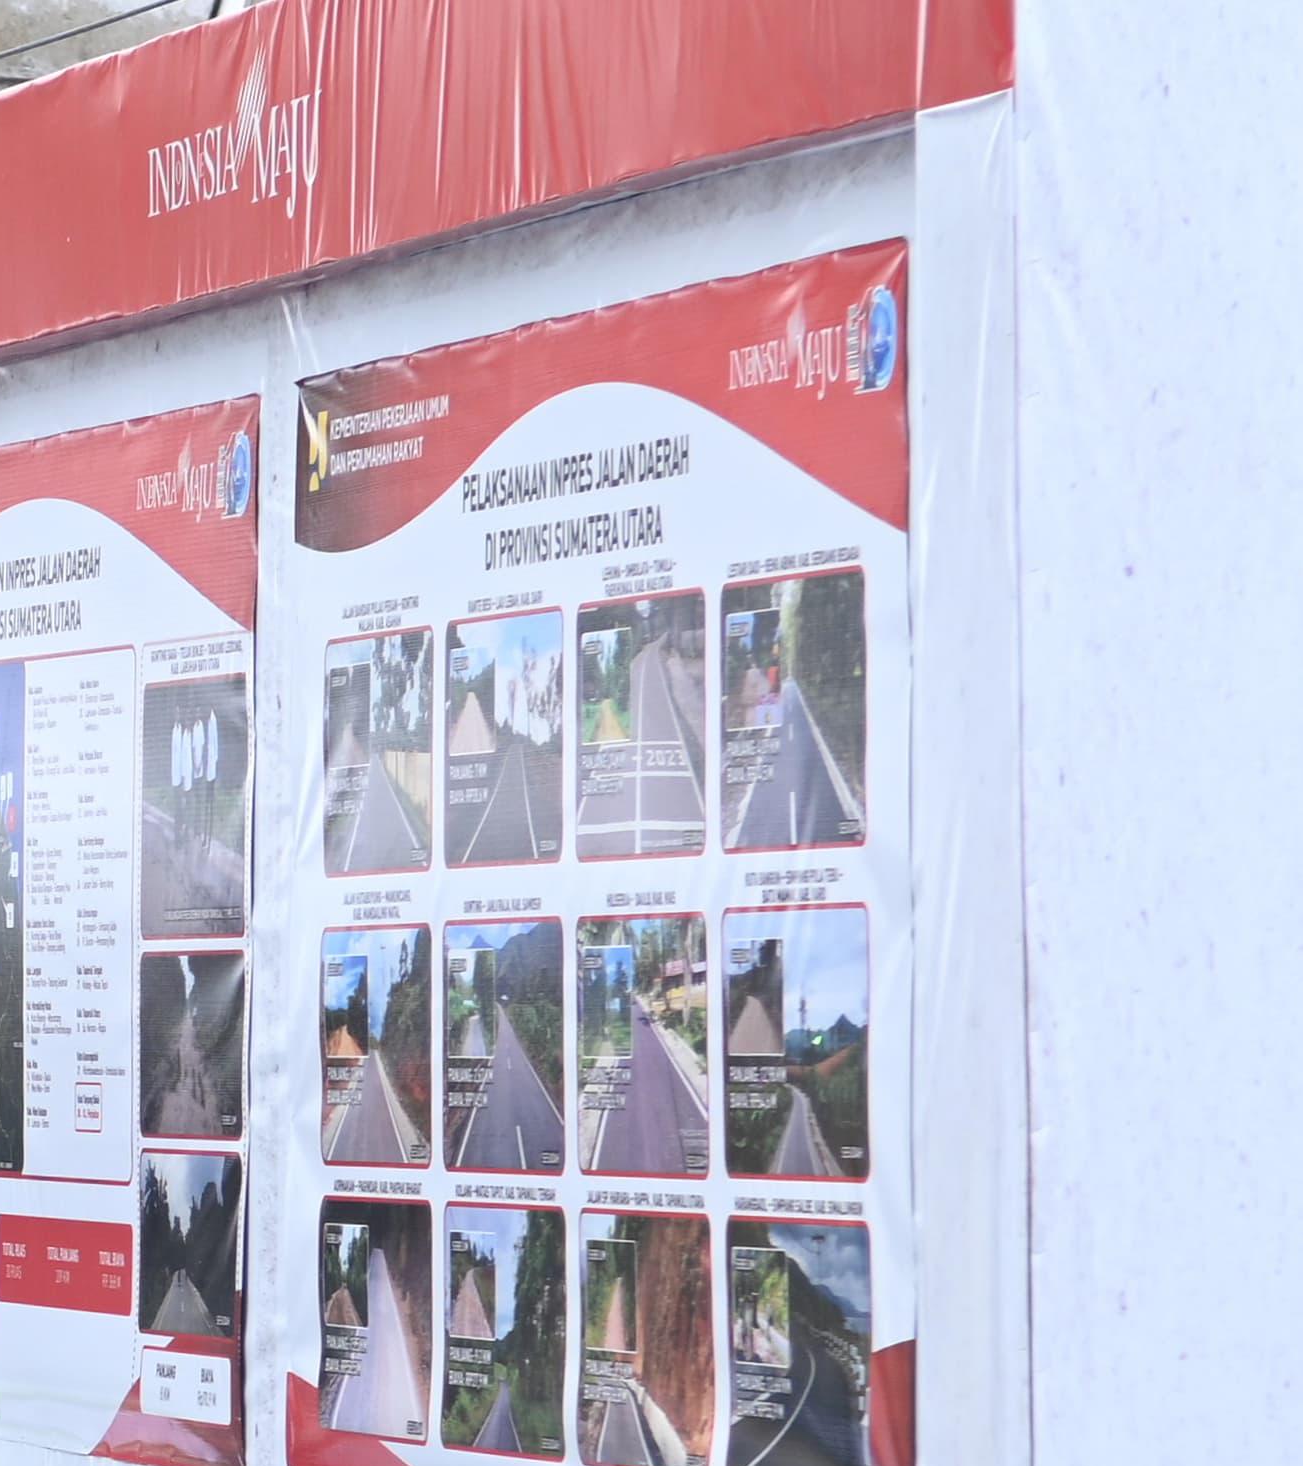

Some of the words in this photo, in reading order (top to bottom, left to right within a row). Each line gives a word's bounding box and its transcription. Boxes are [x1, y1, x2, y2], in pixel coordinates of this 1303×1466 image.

[250, 89, 322, 219] MAJU
[330, 408, 382, 441] KEMENTERIAN
[382, 400, 425, 429] PEKERJAAN
[425, 394, 450, 421] UMUM
[330, 451, 347, 476] DAN
[347, 442, 393, 472] PERUMAHAN
[393, 435, 424, 463] RAKYAT
[462, 461, 548, 512] PELAKSANAAN
[550, 452, 593, 498] INPRES
[596, 444, 636, 490] JALAN
[638, 434, 690, 482] DAERAH
[485, 531, 495, 570] DI
[499, 522, 552, 567] PROVINSI
[555, 512, 618, 559] SUMATERA
[622, 504, 663, 550] UTARA
[6, 556, 36, 591] INPRES
[37, 551, 65, 587] JALAN
[65, 545, 101, 583] DAERAH
[8, 602, 53, 639] SUMATERA
[54, 599, 82, 633] UTARA
[646, 749, 686, 767] 2023
